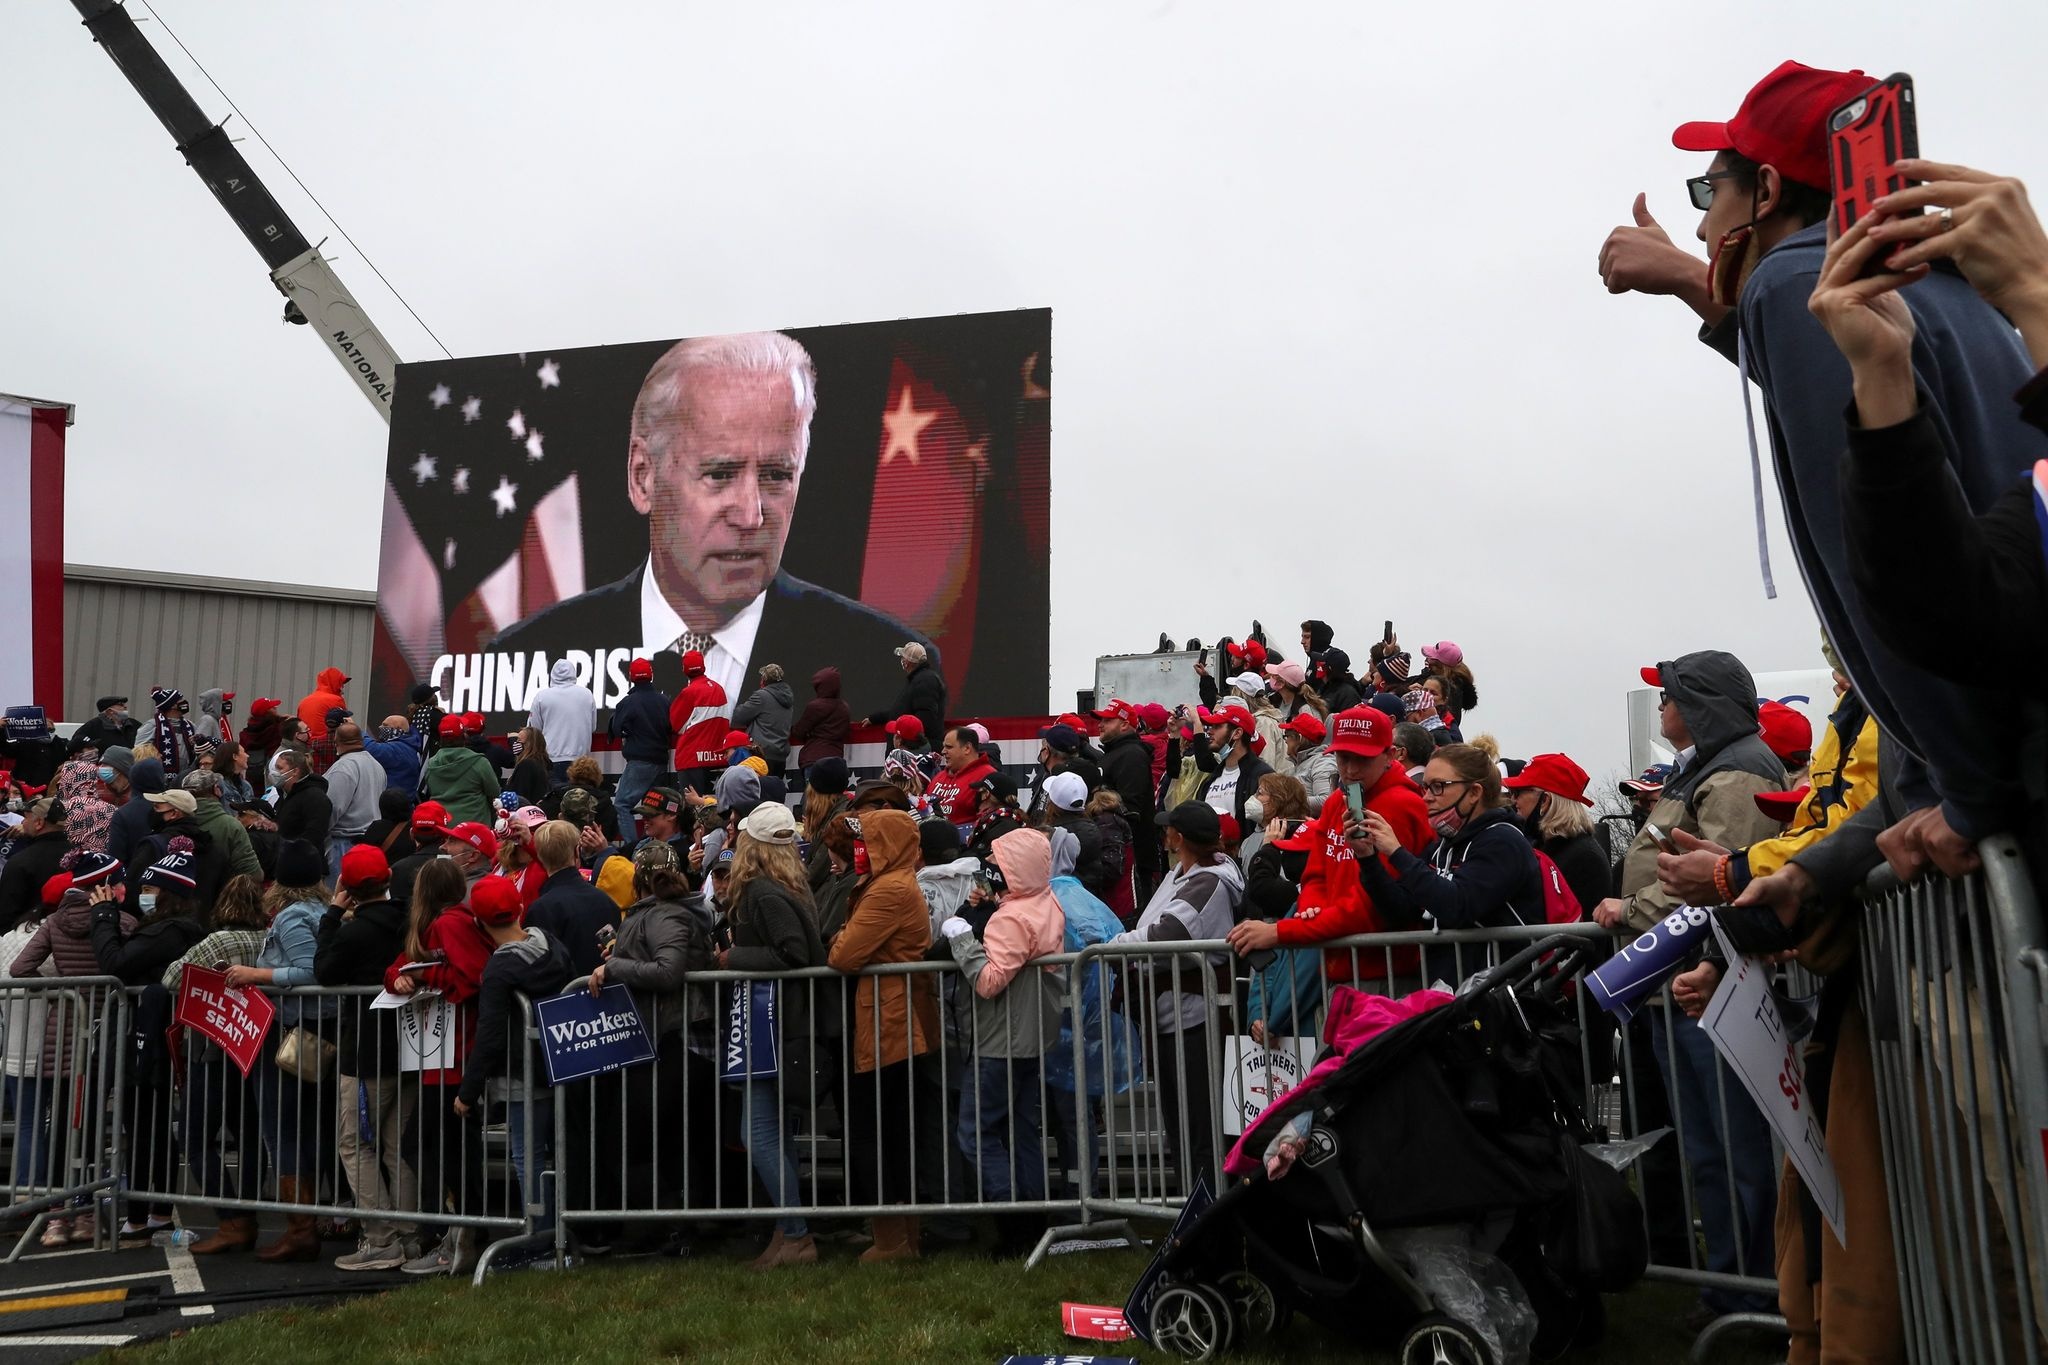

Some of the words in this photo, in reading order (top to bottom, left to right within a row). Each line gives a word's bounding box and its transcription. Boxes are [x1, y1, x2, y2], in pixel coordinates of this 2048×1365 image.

[333, 330, 393, 402] NATIONAL
[430, 650, 551, 715] CHINA
[6, 716, 44, 726] Workers
[1338, 718, 1373, 730] TRUMP
[190, 986, 227, 1013] FILL
[231, 1003, 261, 1040] THAT
[205, 1009, 245, 1047] SEAT!
[547, 1010, 638, 1045] Workers
[574, 1040, 597, 1053] FOR
[599, 1029, 631, 1046] TRUMP
[602, 1062, 619, 1072] 2020
